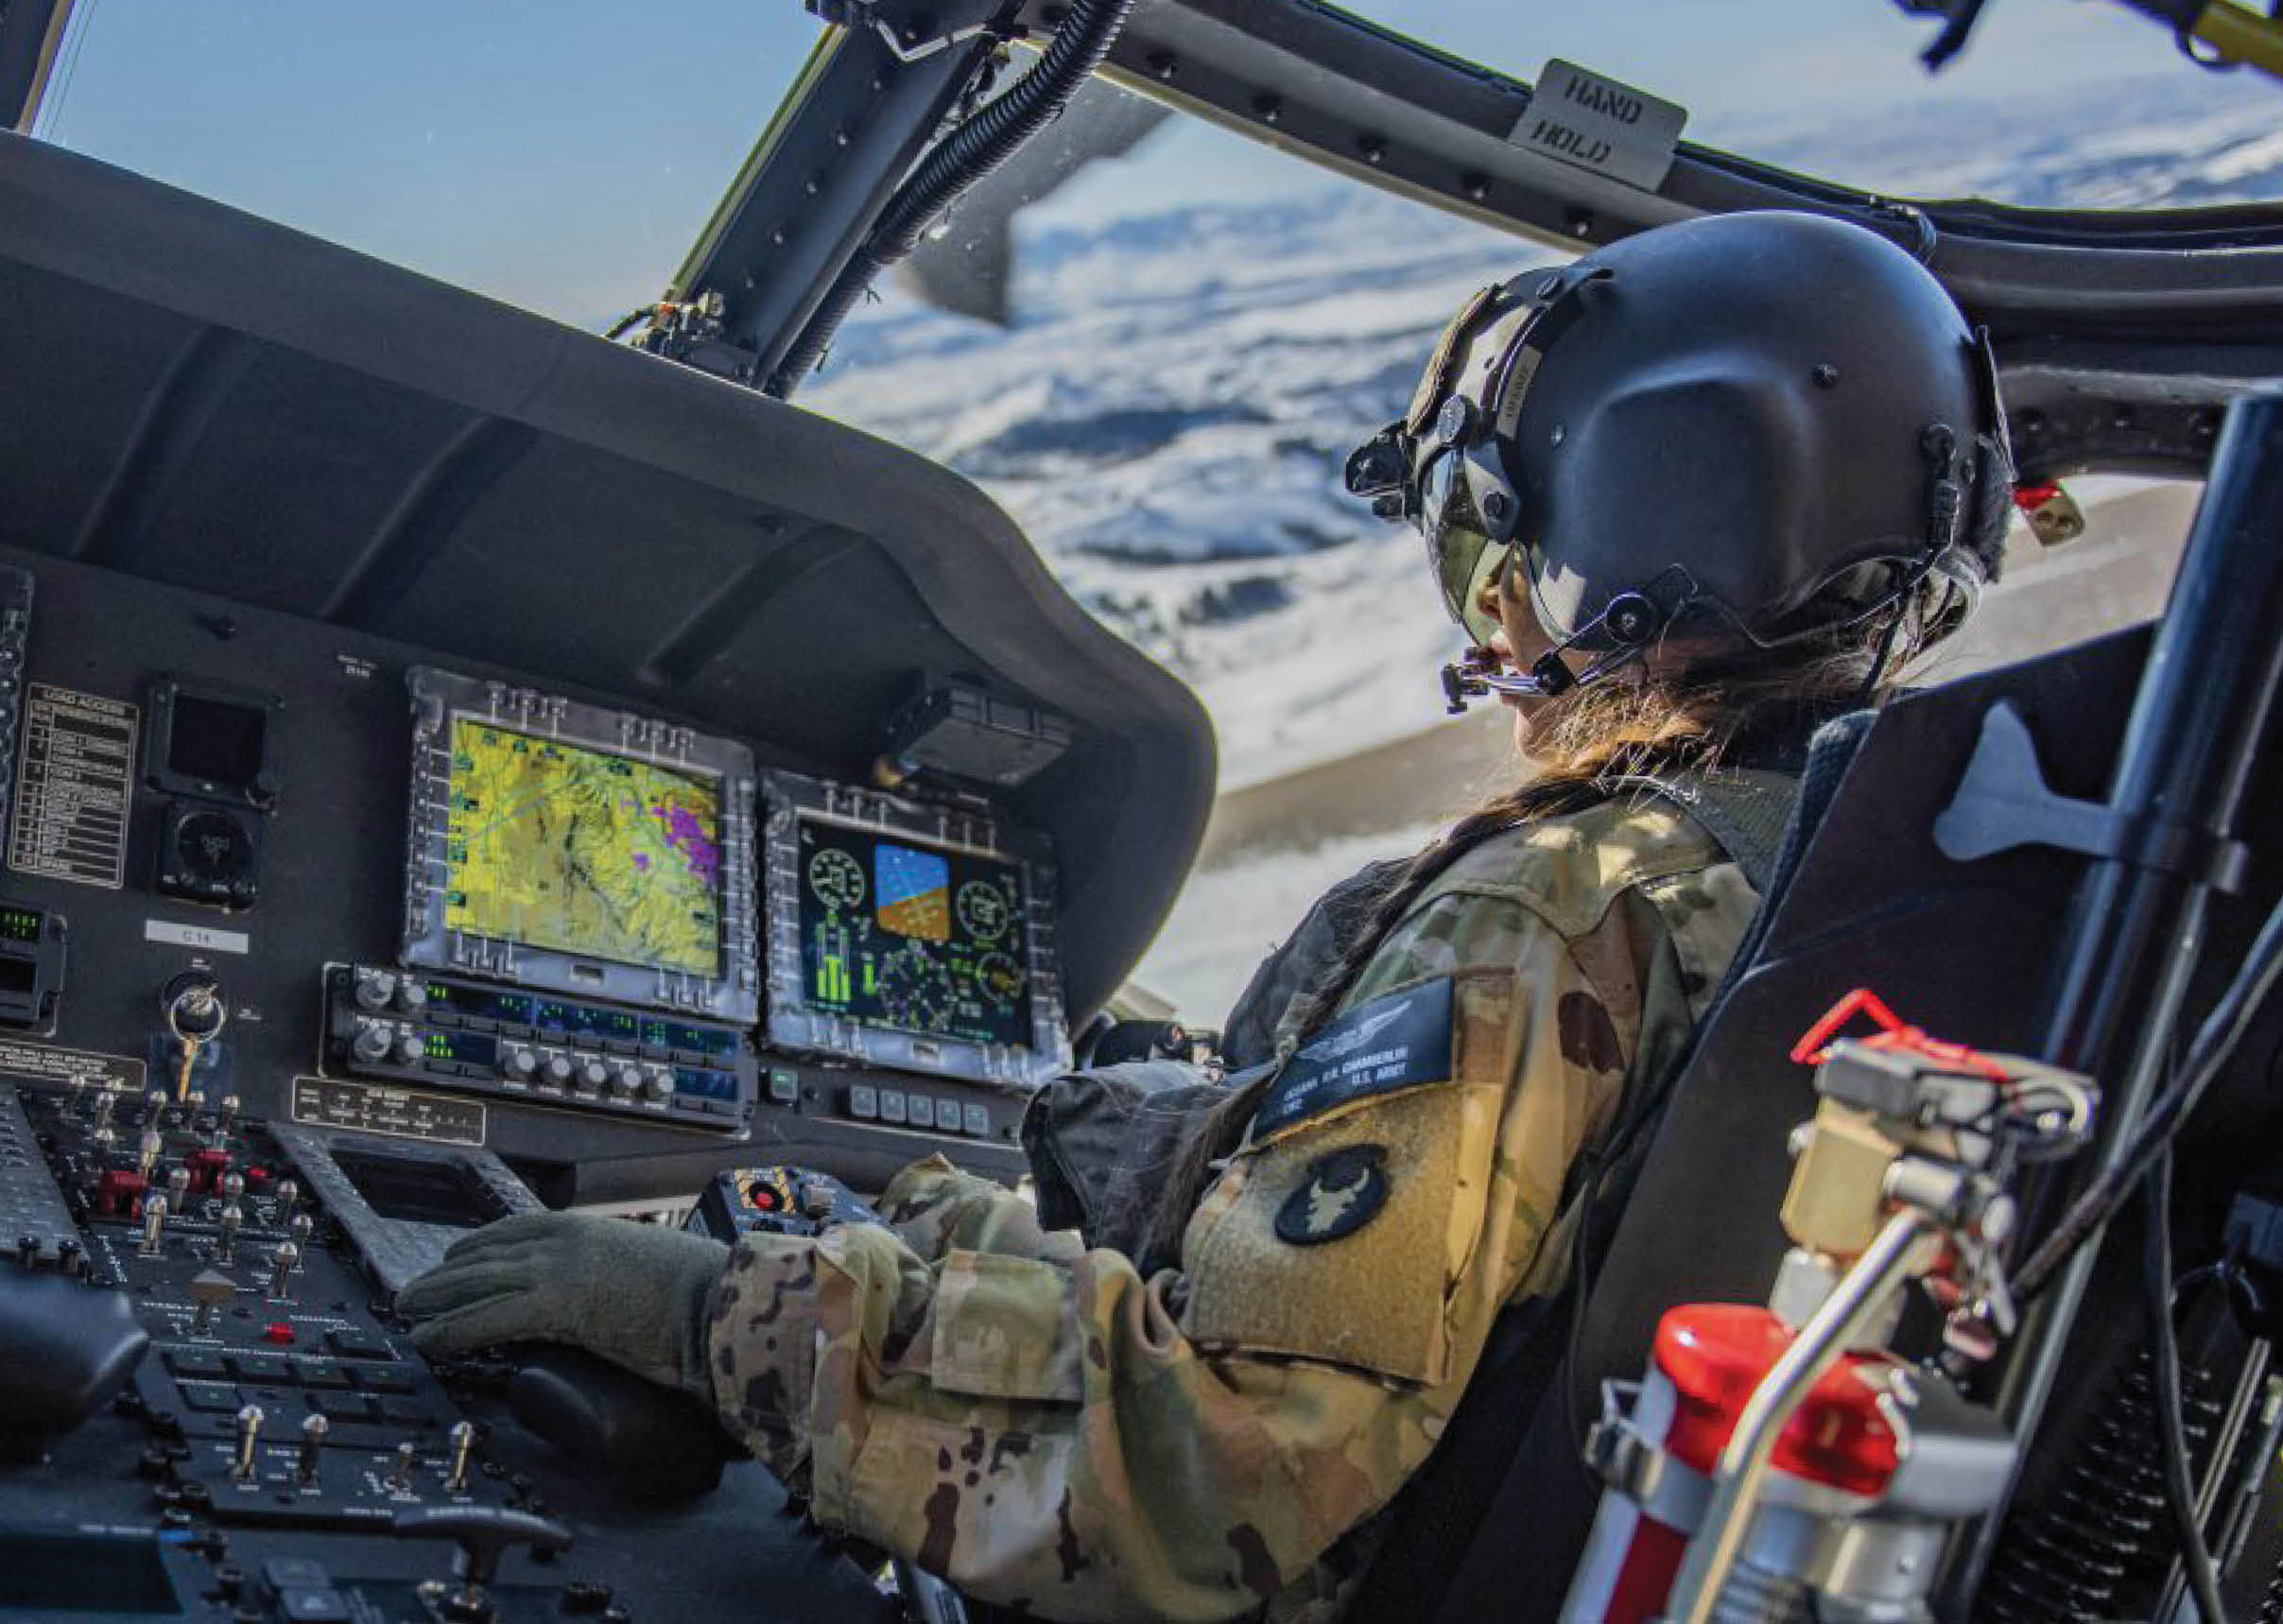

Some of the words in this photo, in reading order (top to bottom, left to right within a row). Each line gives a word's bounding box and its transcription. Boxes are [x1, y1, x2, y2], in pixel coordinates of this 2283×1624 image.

[1565, 76, 1644, 124] HAND
[1531, 120, 1612, 164] HOLD
[1377, 1063, 1406, 1080] ARMY
